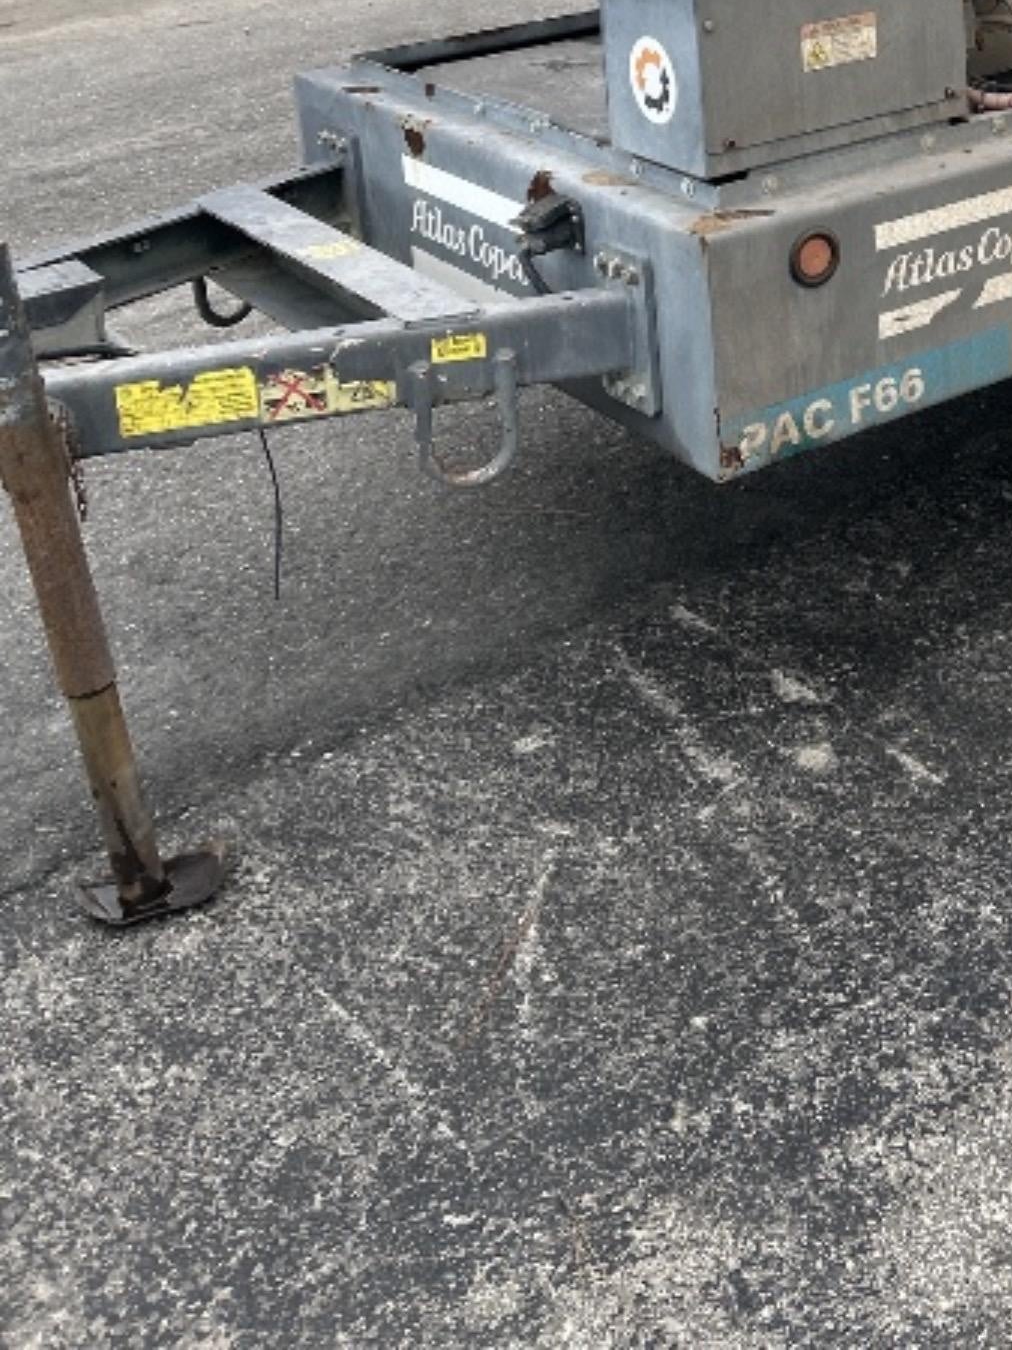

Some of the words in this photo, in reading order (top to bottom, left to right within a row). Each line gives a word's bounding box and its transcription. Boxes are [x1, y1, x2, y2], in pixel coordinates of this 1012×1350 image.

[410, 199, 465, 256] Atlas
[880, 248, 974, 299] Atlas
[739, 397, 835, 461] PAC
[849, 367, 926, 425] F66
